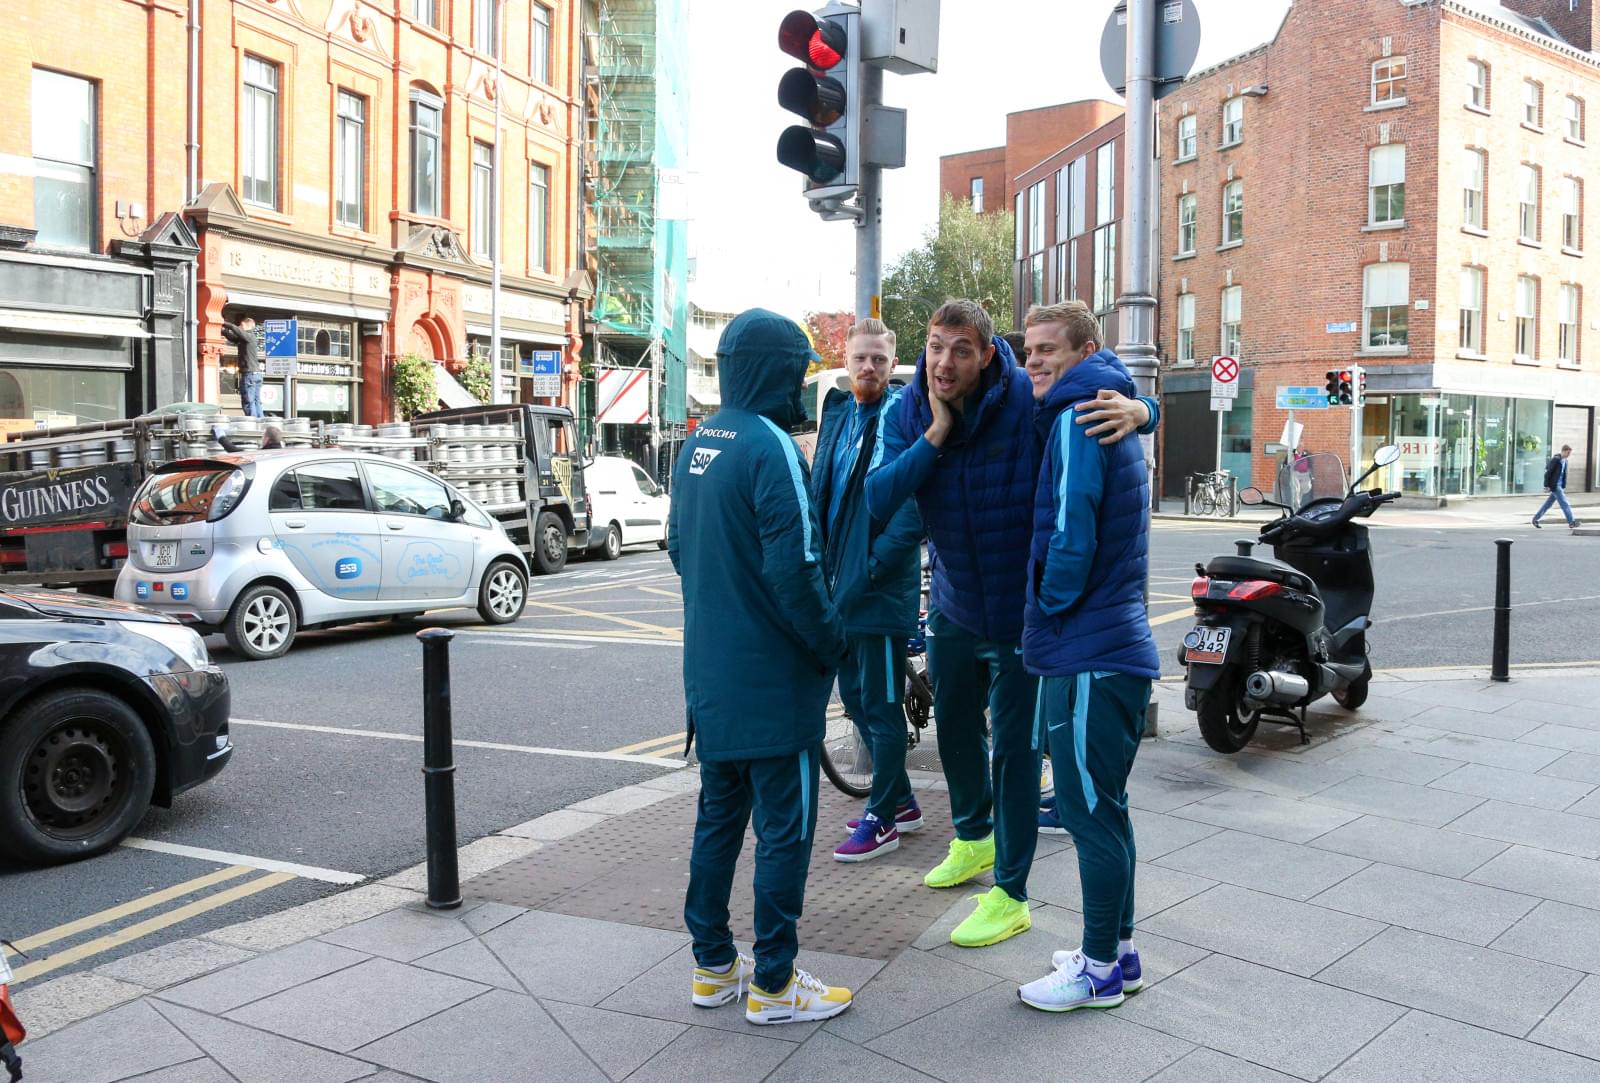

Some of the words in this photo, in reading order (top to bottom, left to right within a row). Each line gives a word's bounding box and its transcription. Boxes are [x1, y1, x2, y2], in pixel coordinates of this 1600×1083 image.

[702, 428, 738, 440] РОССИЯ
[691, 452, 711, 470] SAP
[2, 476, 111, 522] GUINNESS
